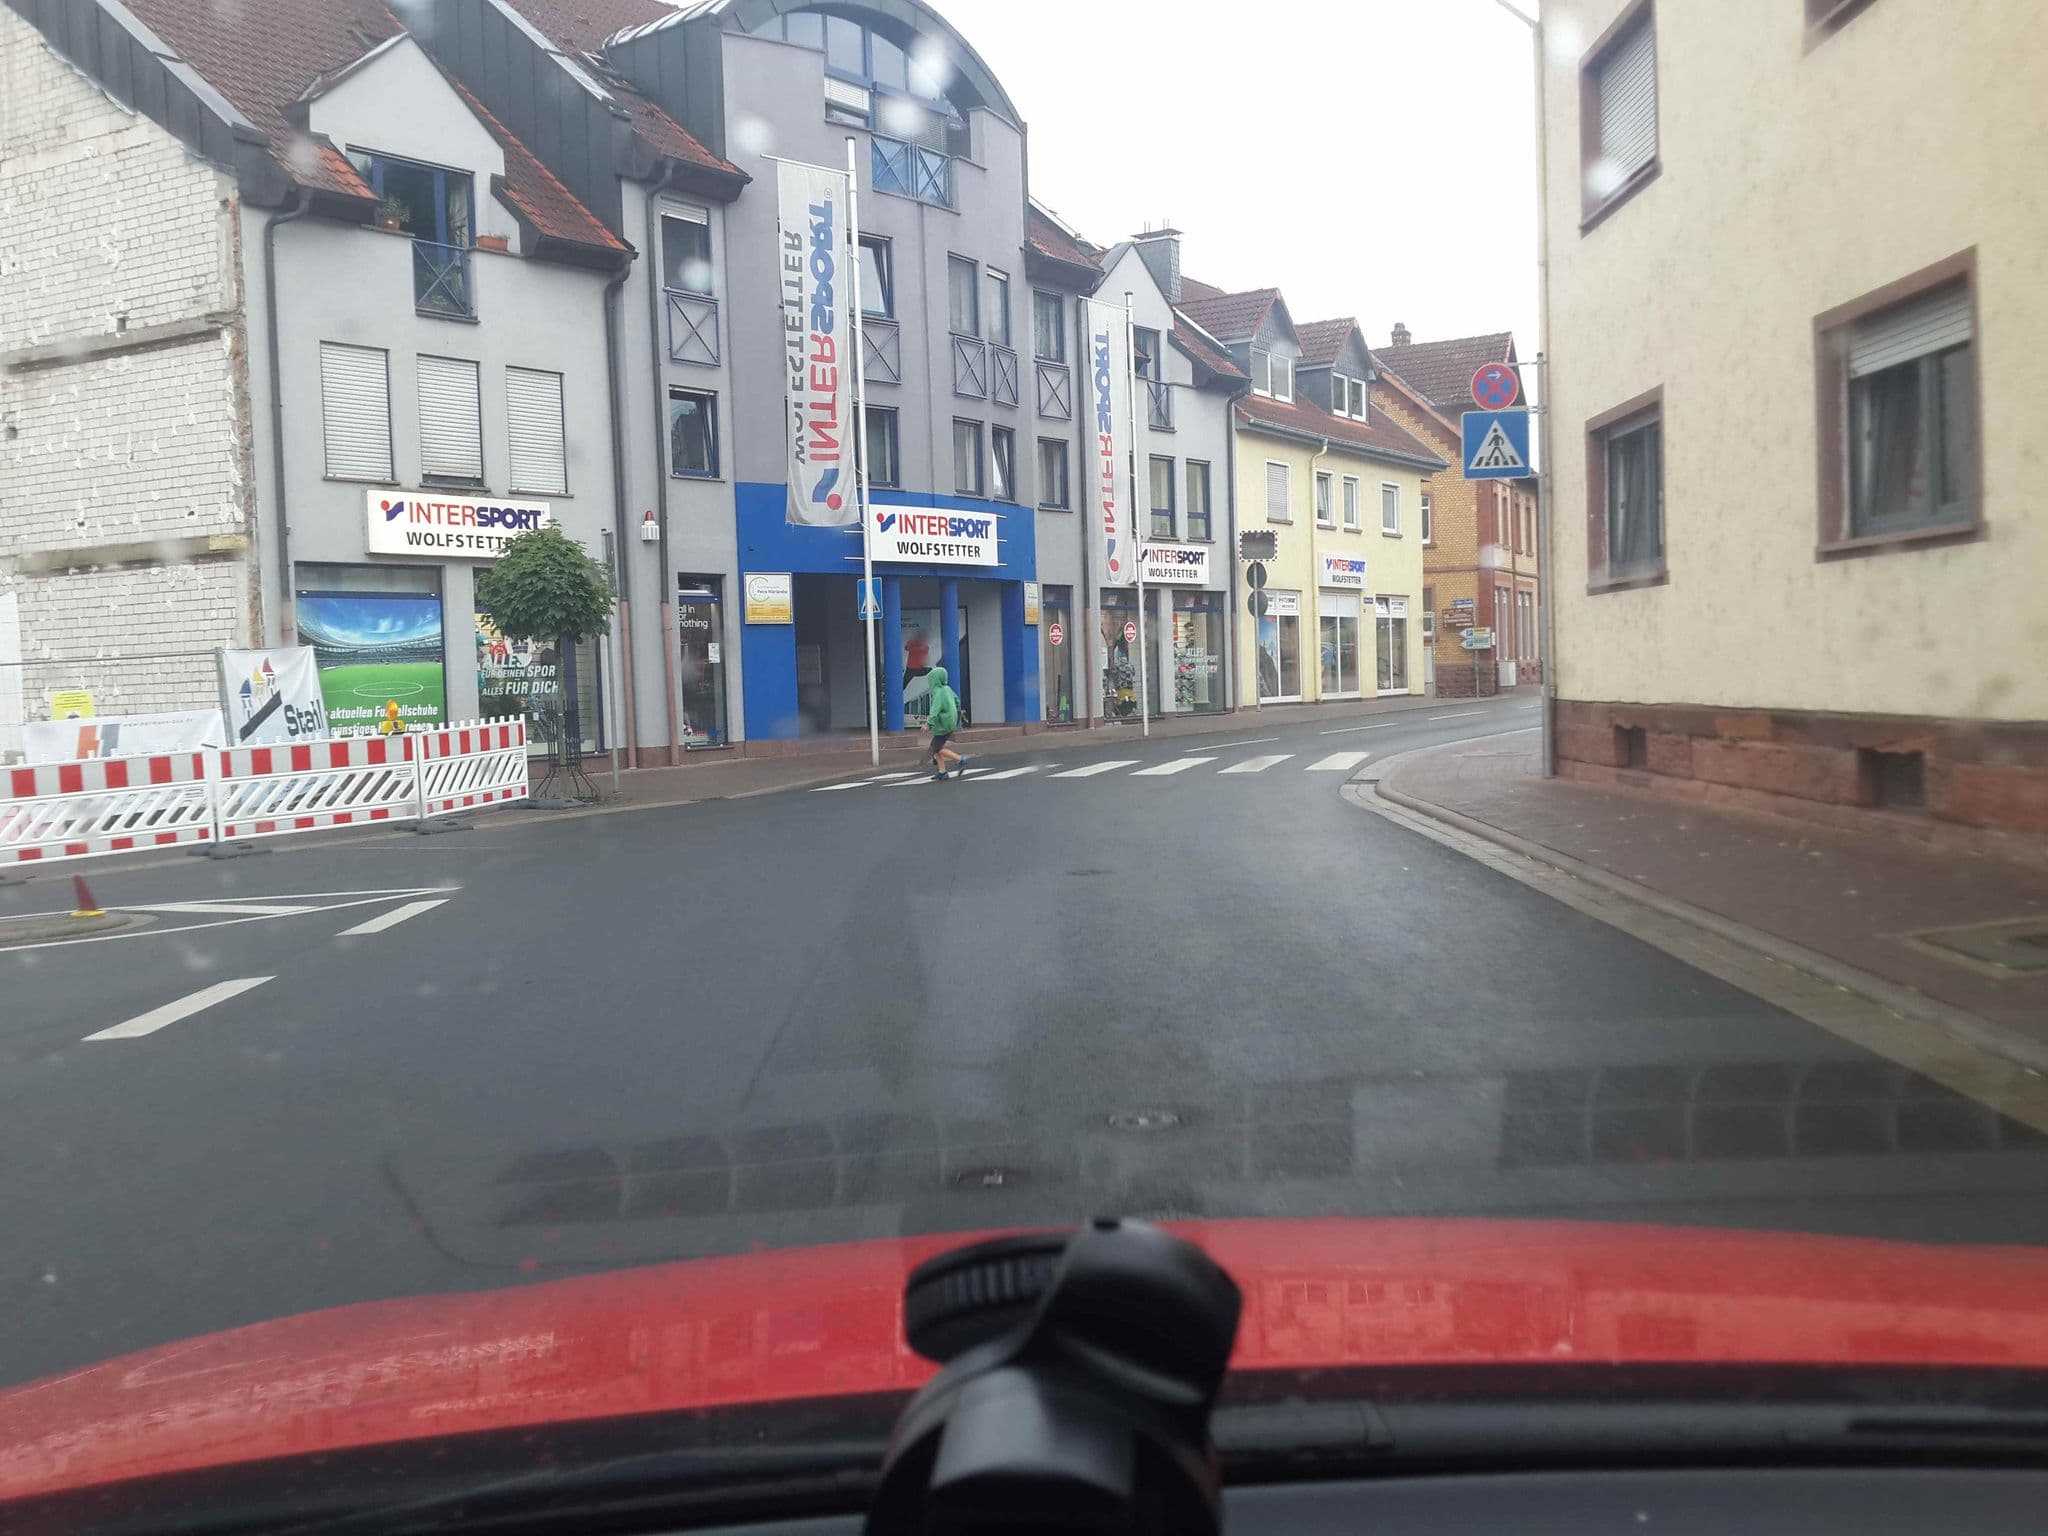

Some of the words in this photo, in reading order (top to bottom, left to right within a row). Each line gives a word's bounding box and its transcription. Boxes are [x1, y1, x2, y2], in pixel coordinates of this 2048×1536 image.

[409, 501, 541, 529] INTERSPORT
[898, 513, 991, 539] INTERSPORT
[406, 531, 513, 550] WOLFSTETT
[897, 541, 981, 558] WOLFSTETTER
[1149, 548, 1206, 565] INTERSPORT
[1148, 567, 1198, 578] WOLFSTETTER
[679, 619, 709, 630] nothing
[527, 665, 556, 678] SPOR
[482, 687, 505, 696] ALLES
[505, 679, 529, 695] FÜR
[283, 699, 325, 737] Stahl
[329, 706, 373, 719] aktuellen
[374, 703, 438, 719] Fuallschuhe
